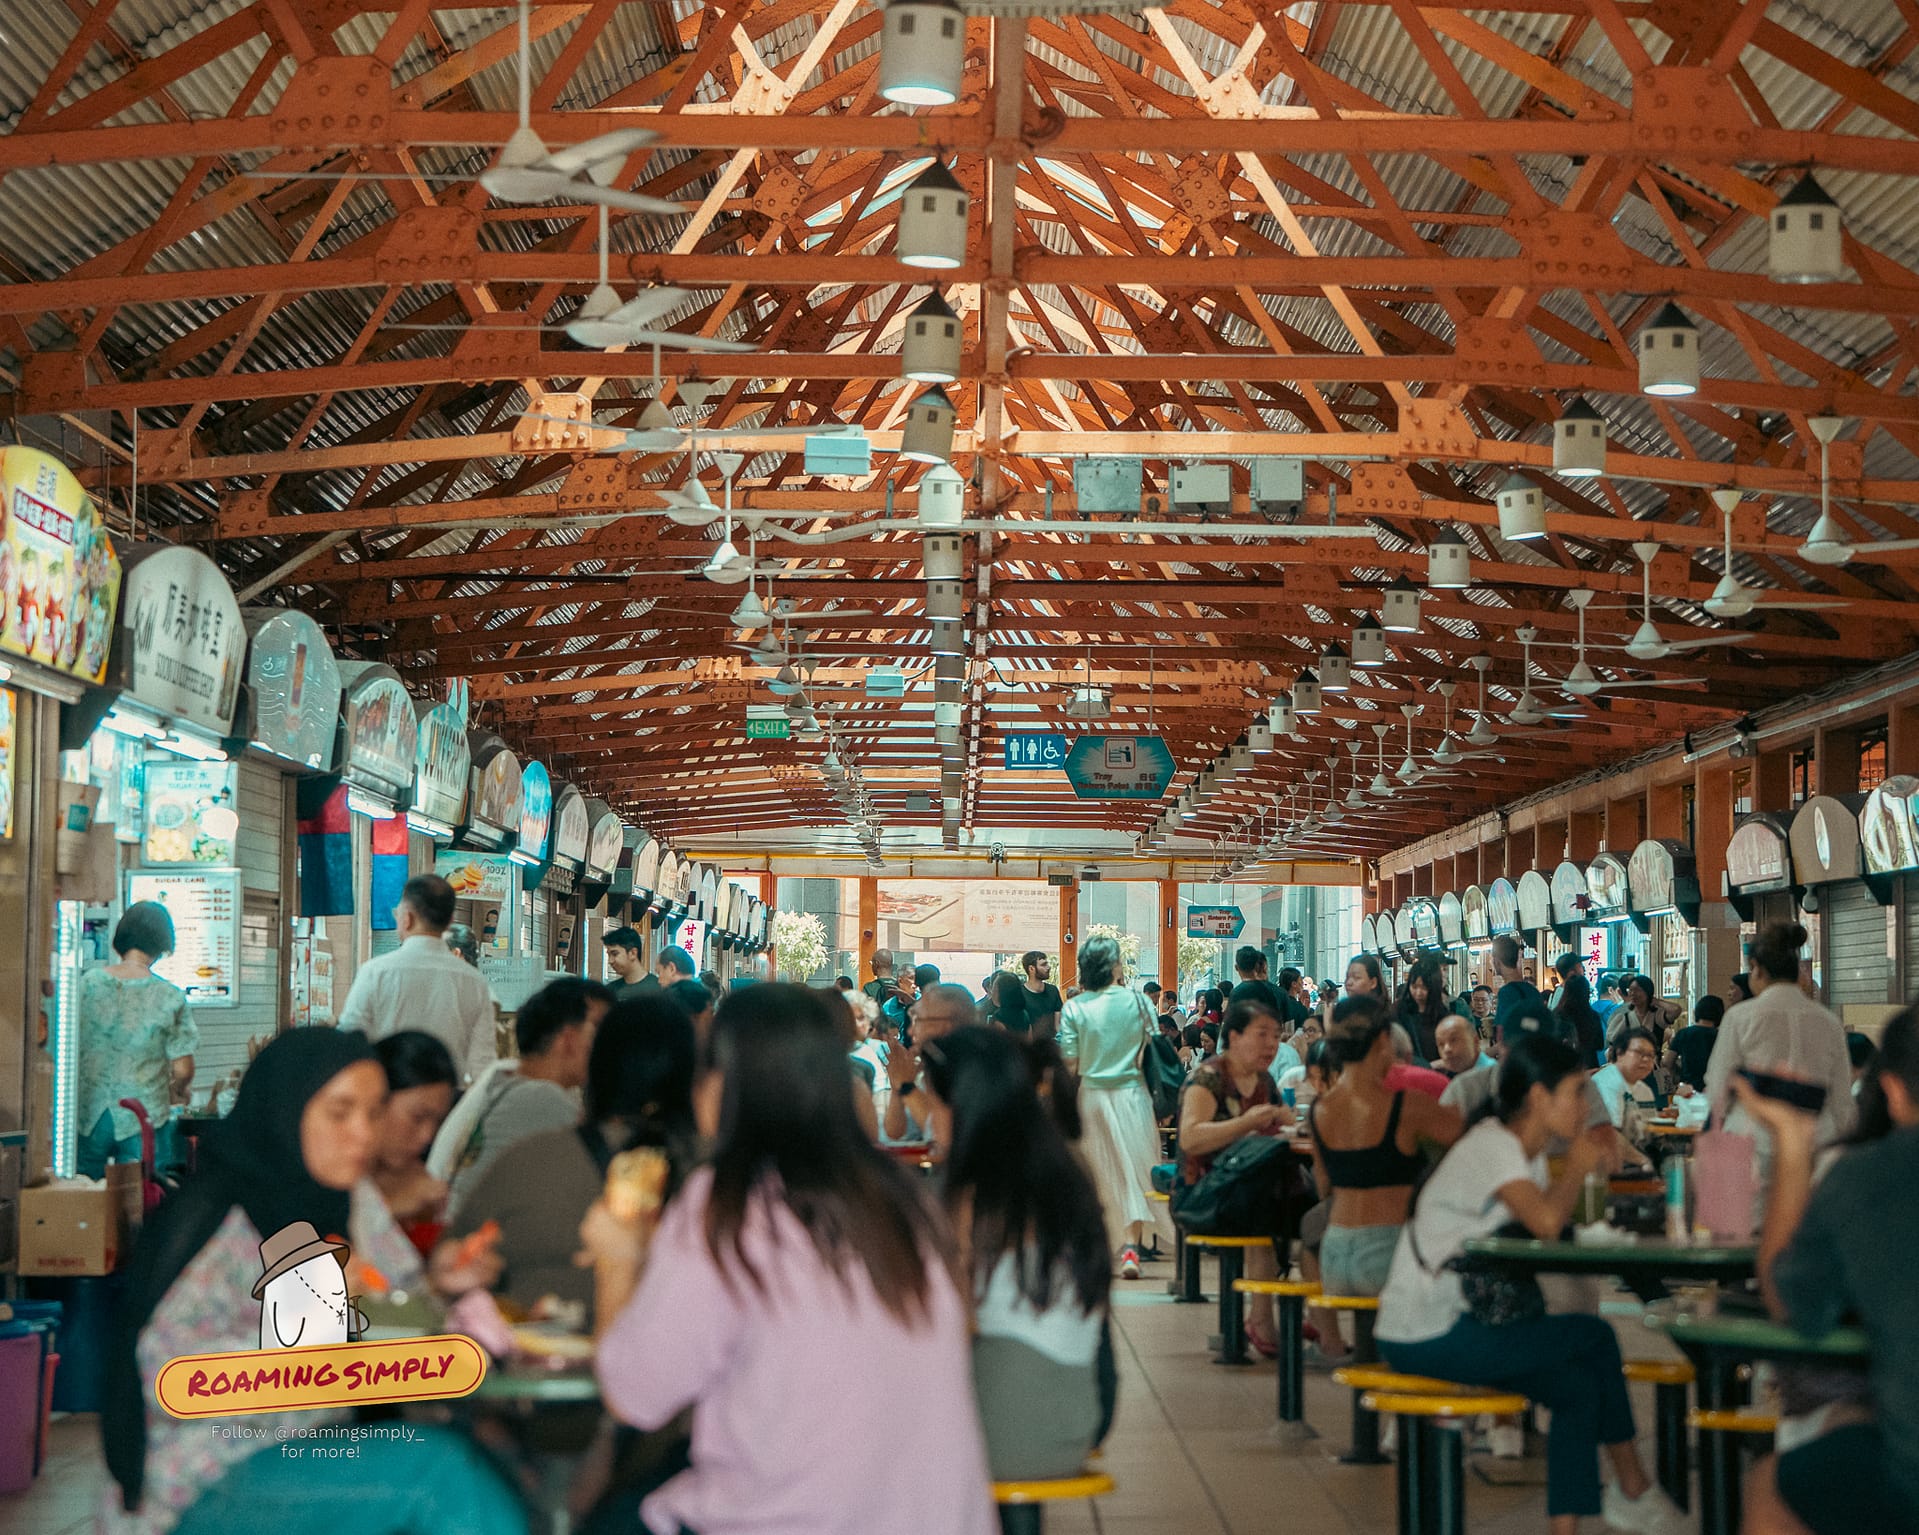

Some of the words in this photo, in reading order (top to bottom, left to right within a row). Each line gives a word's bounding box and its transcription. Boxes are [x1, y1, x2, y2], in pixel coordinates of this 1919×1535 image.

[755, 720, 781, 735] EXIT
[1093, 772, 1113, 781] Tray
[486, 865, 507, 876] 100%
